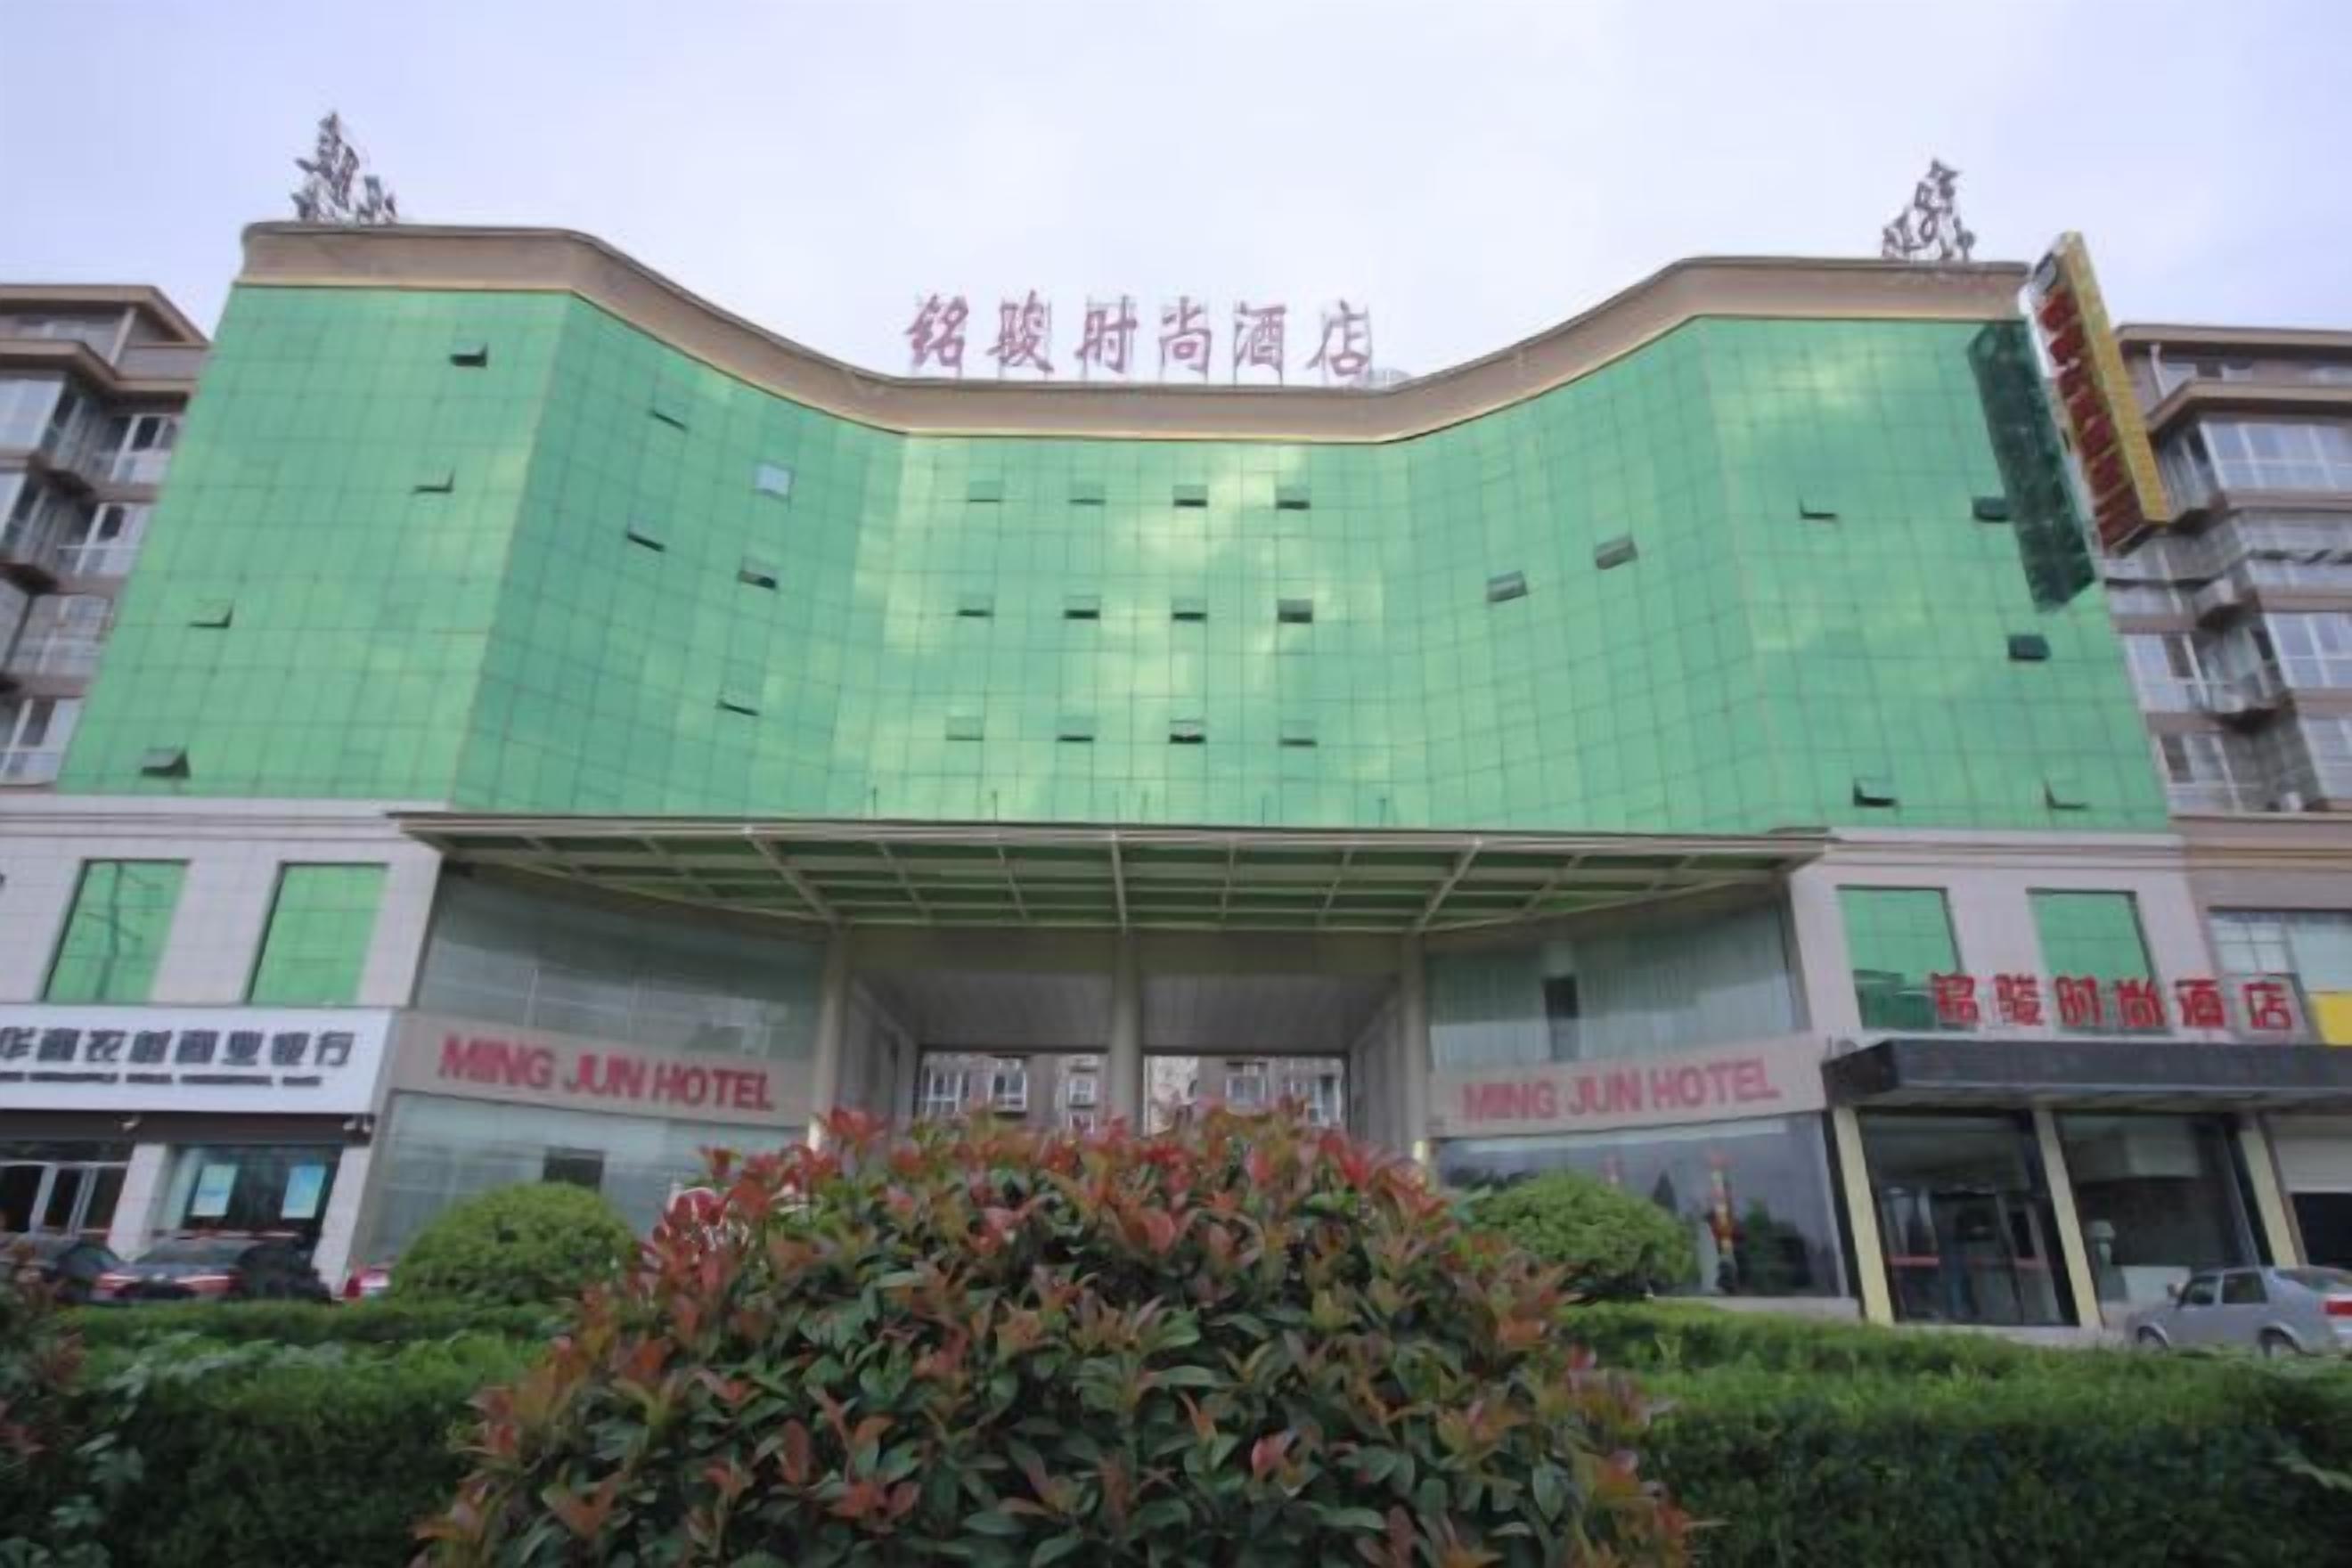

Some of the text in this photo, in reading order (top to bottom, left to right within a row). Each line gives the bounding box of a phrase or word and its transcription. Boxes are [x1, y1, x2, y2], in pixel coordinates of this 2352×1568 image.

[906, 290, 1372, 376] 铭骏时尚酒店
[1932, 974, 2292, 1030] 铭骏时尚酒店
[438, 1033, 775, 1112] MING JUN HOTEL
[1463, 1058, 1781, 1122] MING JUN HOTEL
